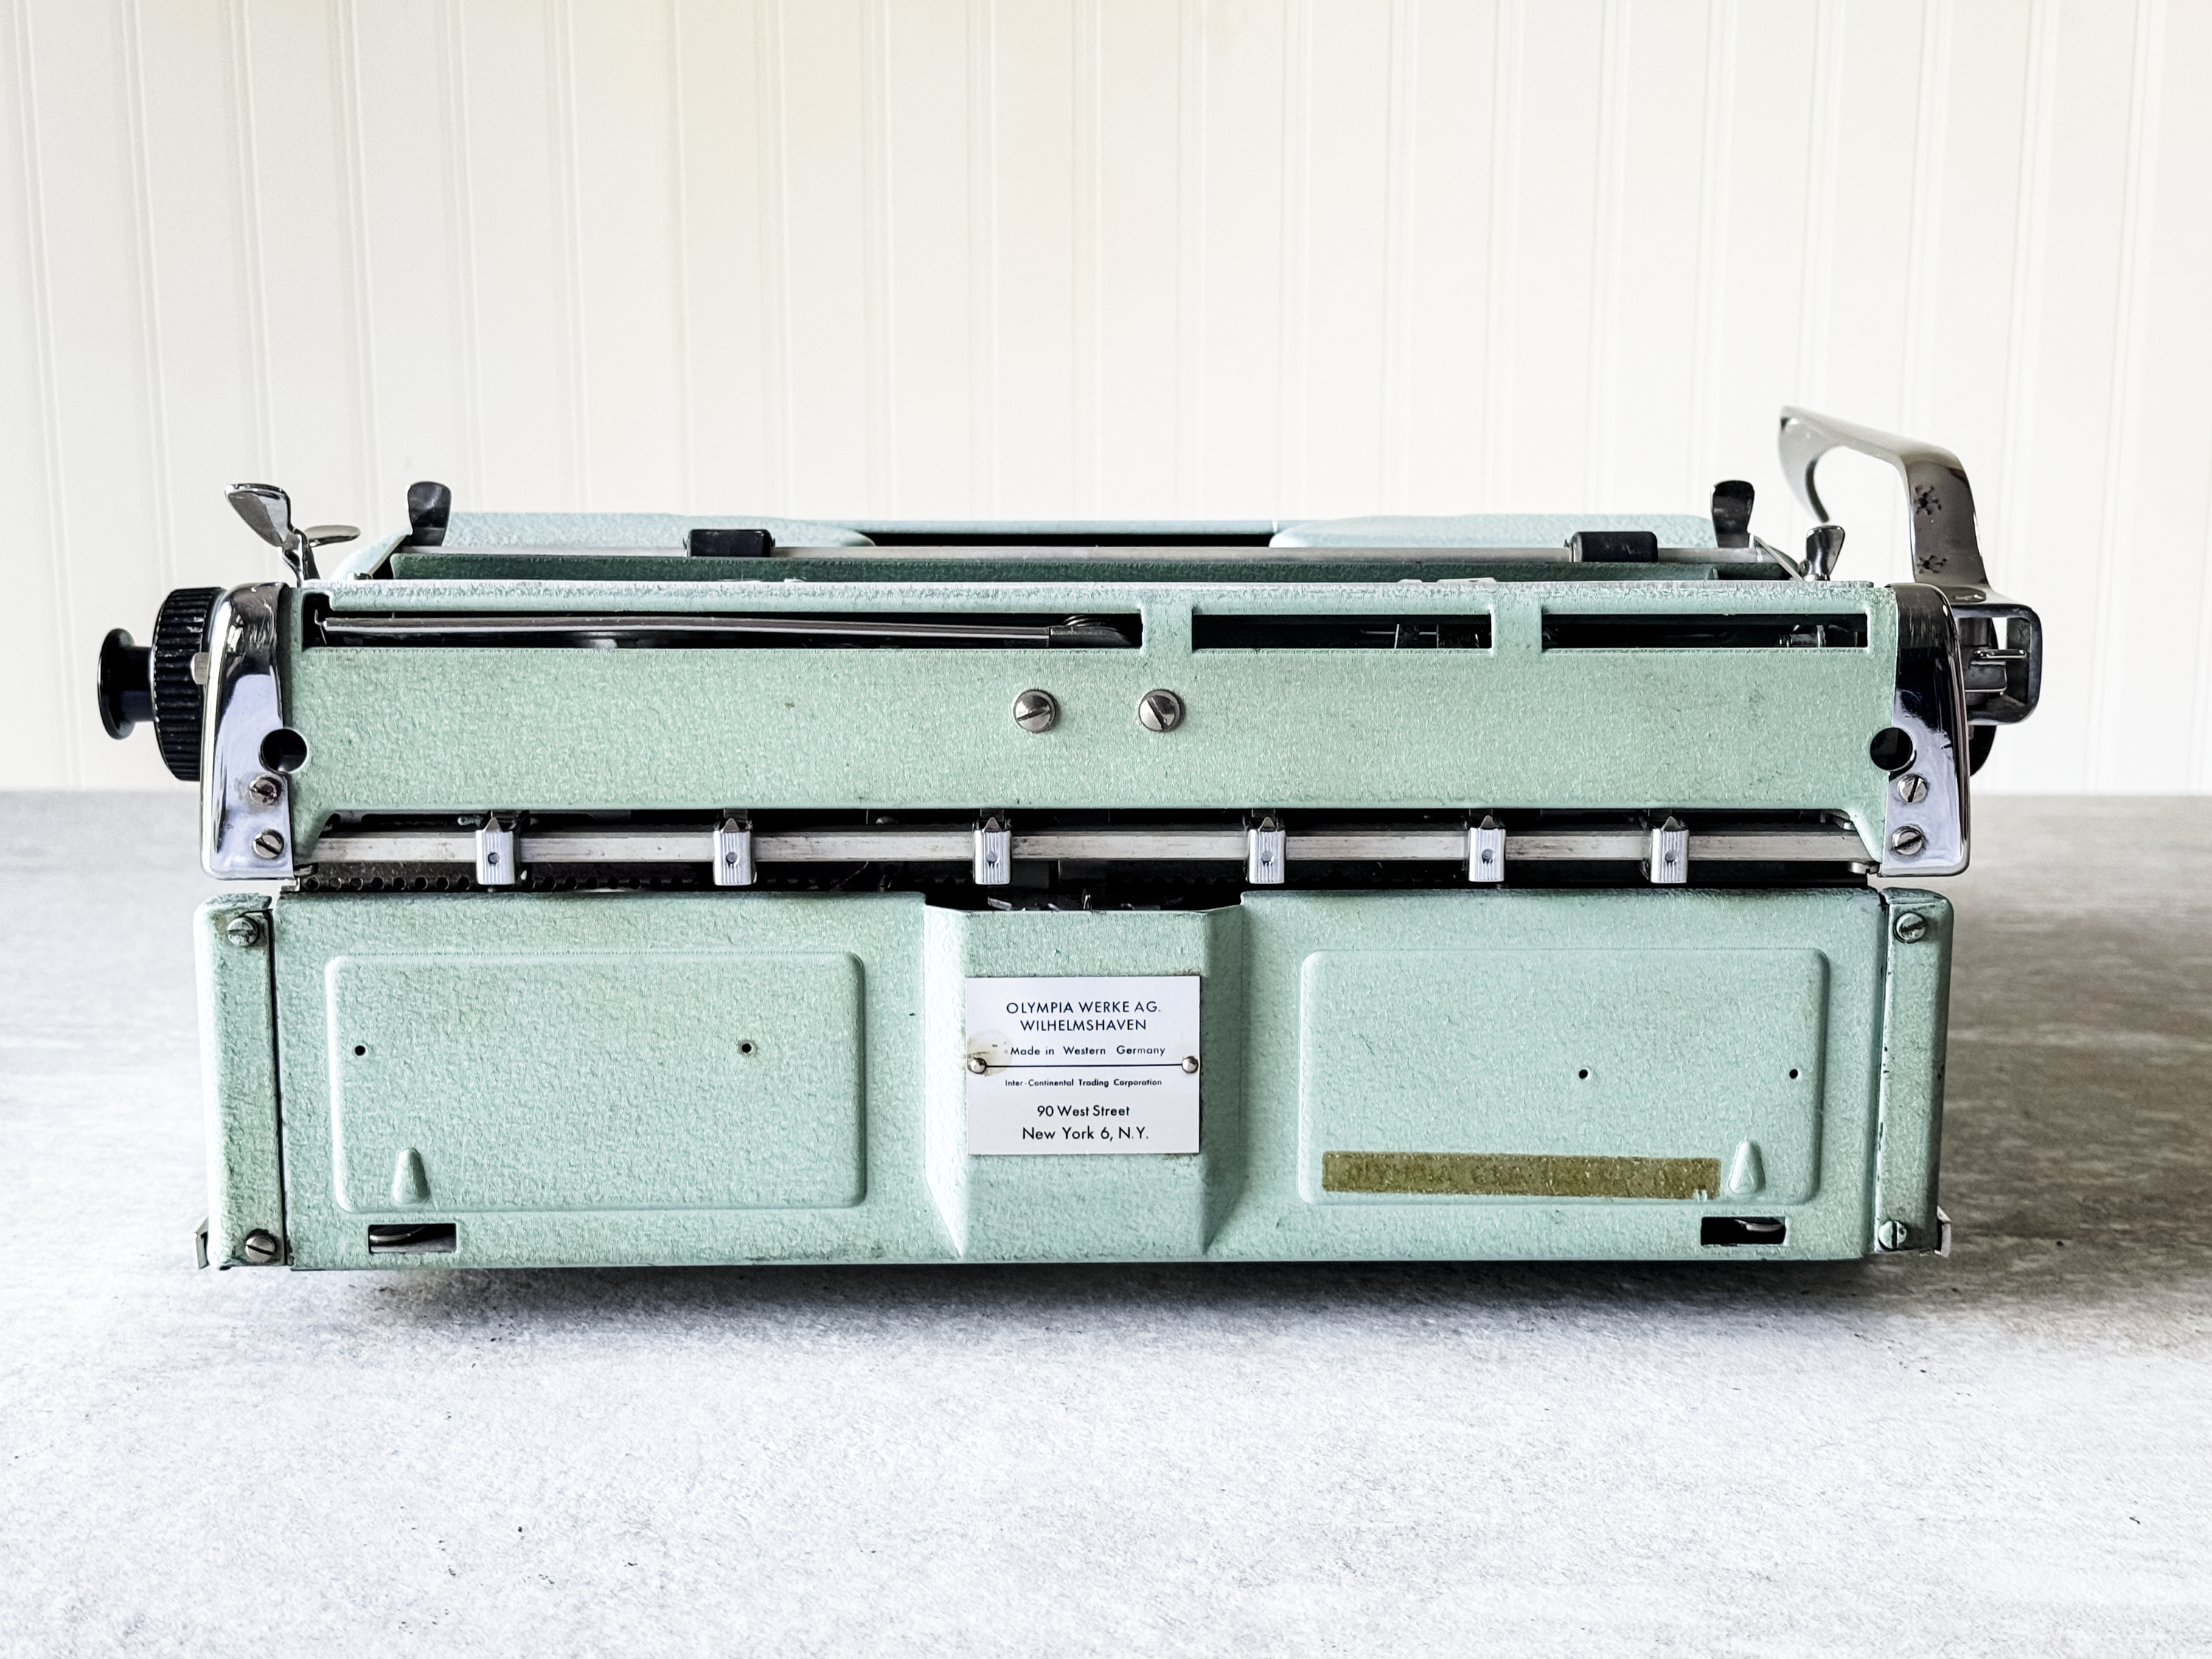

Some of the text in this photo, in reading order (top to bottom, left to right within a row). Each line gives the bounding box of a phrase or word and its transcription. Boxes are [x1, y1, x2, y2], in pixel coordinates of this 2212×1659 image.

[1006, 1002, 1074, 1014] OLYMPIA
[1078, 1001, 1129, 1012] WERKE
[1020, 1019, 1146, 1031] WILHELMSHAVEN
[1010, 1046, 1165, 1057] Made in Western Germany
[1078, 1078, 1109, 1088] Trading
[1113, 1078, 1162, 1088] Corporation
[1037, 1105, 1130, 1117] 90 West Street
[1023, 1125, 1148, 1142] New York 6, N.Y.
